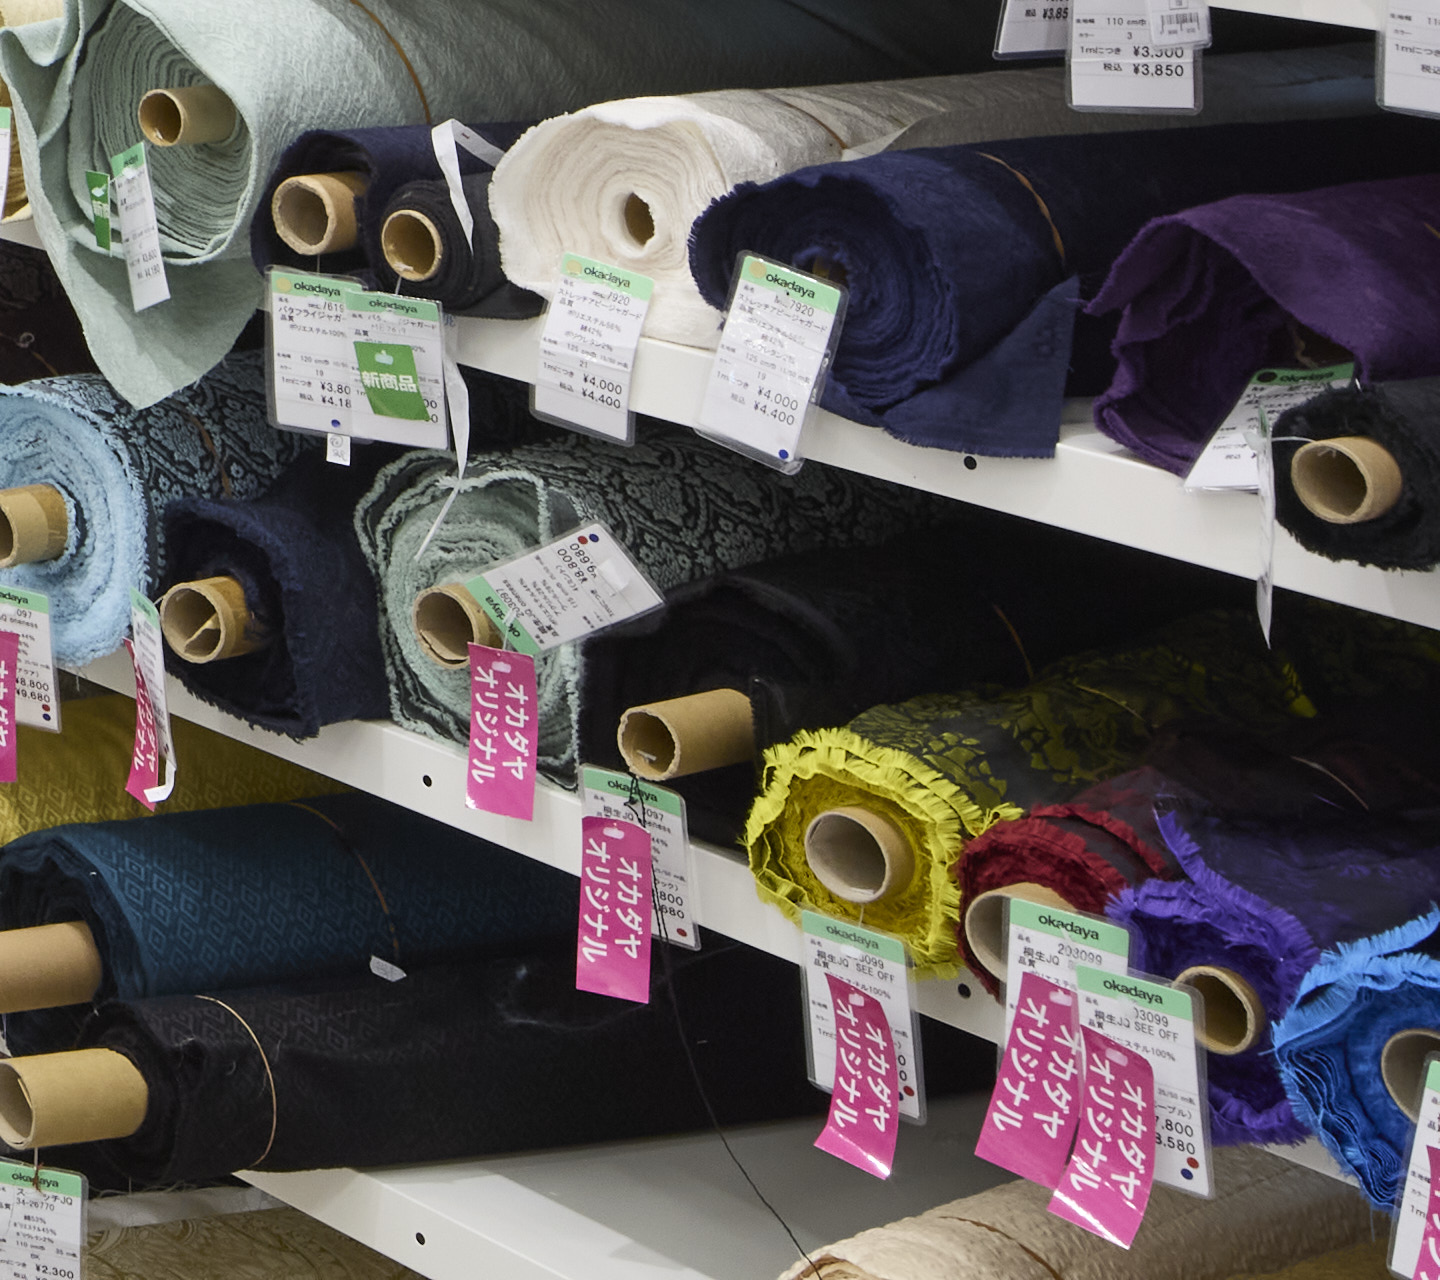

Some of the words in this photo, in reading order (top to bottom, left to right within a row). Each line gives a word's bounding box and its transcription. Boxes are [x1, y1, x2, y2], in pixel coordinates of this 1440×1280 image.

[1106, 17, 1123, 26] 110
[1103, 63, 1122, 72] 税込
[294, 282, 341, 297] okadaya
[369, 299, 418, 313] okadaya
[583, 266, 631, 288] okadaya
[765, 273, 815, 300] okadaya
[361, 371, 418, 393] 新商品
[472, 665, 499, 784] オリジナル
[502, 680, 529, 781] オカダヤ
[582, 837, 611, 963] オリジナル
[614, 857, 643, 959] オカダヤ
[1038, 914, 1099, 941] okadaya
[826, 924, 879, 950] okadaya
[1103, 978, 1163, 1005] okadaya
[834, 999, 862, 1128] オリジナル
[865, 1022, 891, 1132] オカダヤ
[992, 998, 1049, 1131] オリジナル
[1033, 1025, 1082, 1139] オカダヤ
[1069, 1053, 1115, 1191] オリジナル
[1110, 1079, 1147, 1201] オカダヤ
